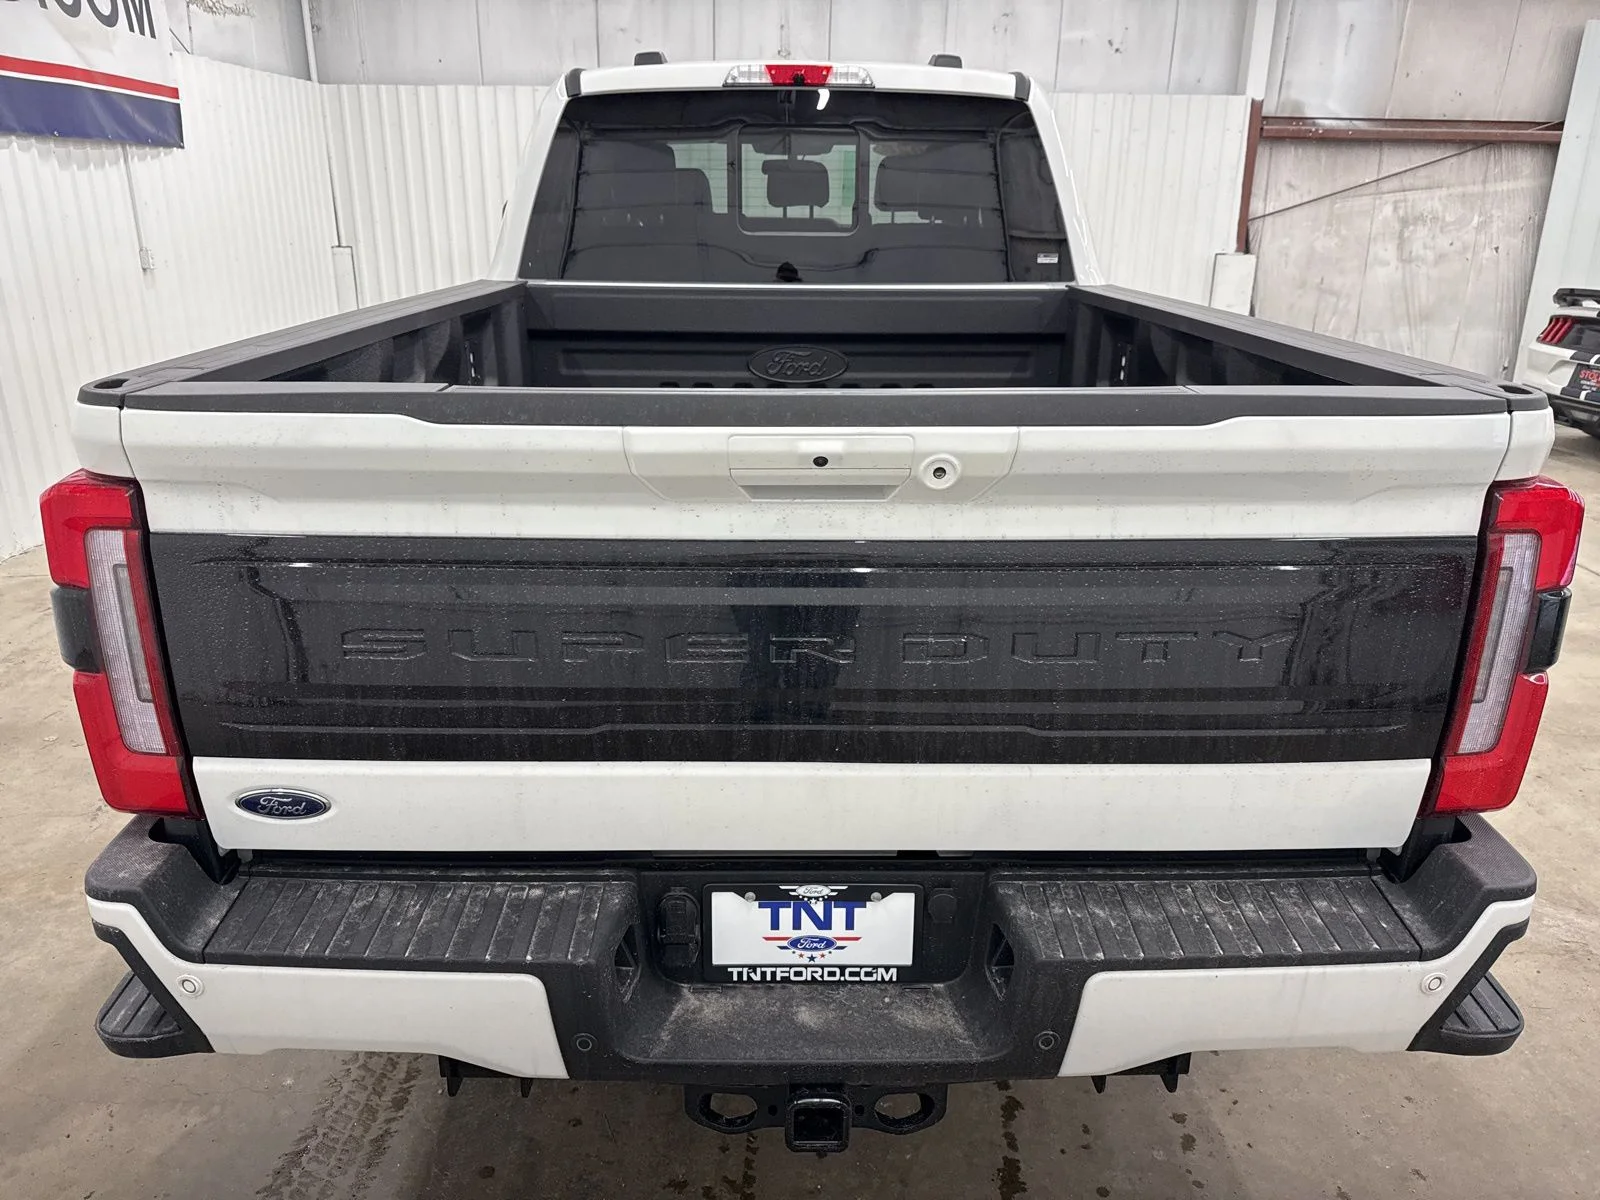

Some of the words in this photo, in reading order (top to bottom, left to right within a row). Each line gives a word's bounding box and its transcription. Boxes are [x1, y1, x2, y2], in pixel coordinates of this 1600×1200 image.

[766, 349, 828, 376] Ford
[341, 628, 856, 664] SUPER
[902, 629, 1298, 664] DUTY
[257, 796, 307, 815] Ford
[803, 885, 825, 896] Ford
[758, 900, 867, 931] TNT
[797, 937, 827, 950] Ford
[727, 967, 898, 982] TNTFORD.COM
